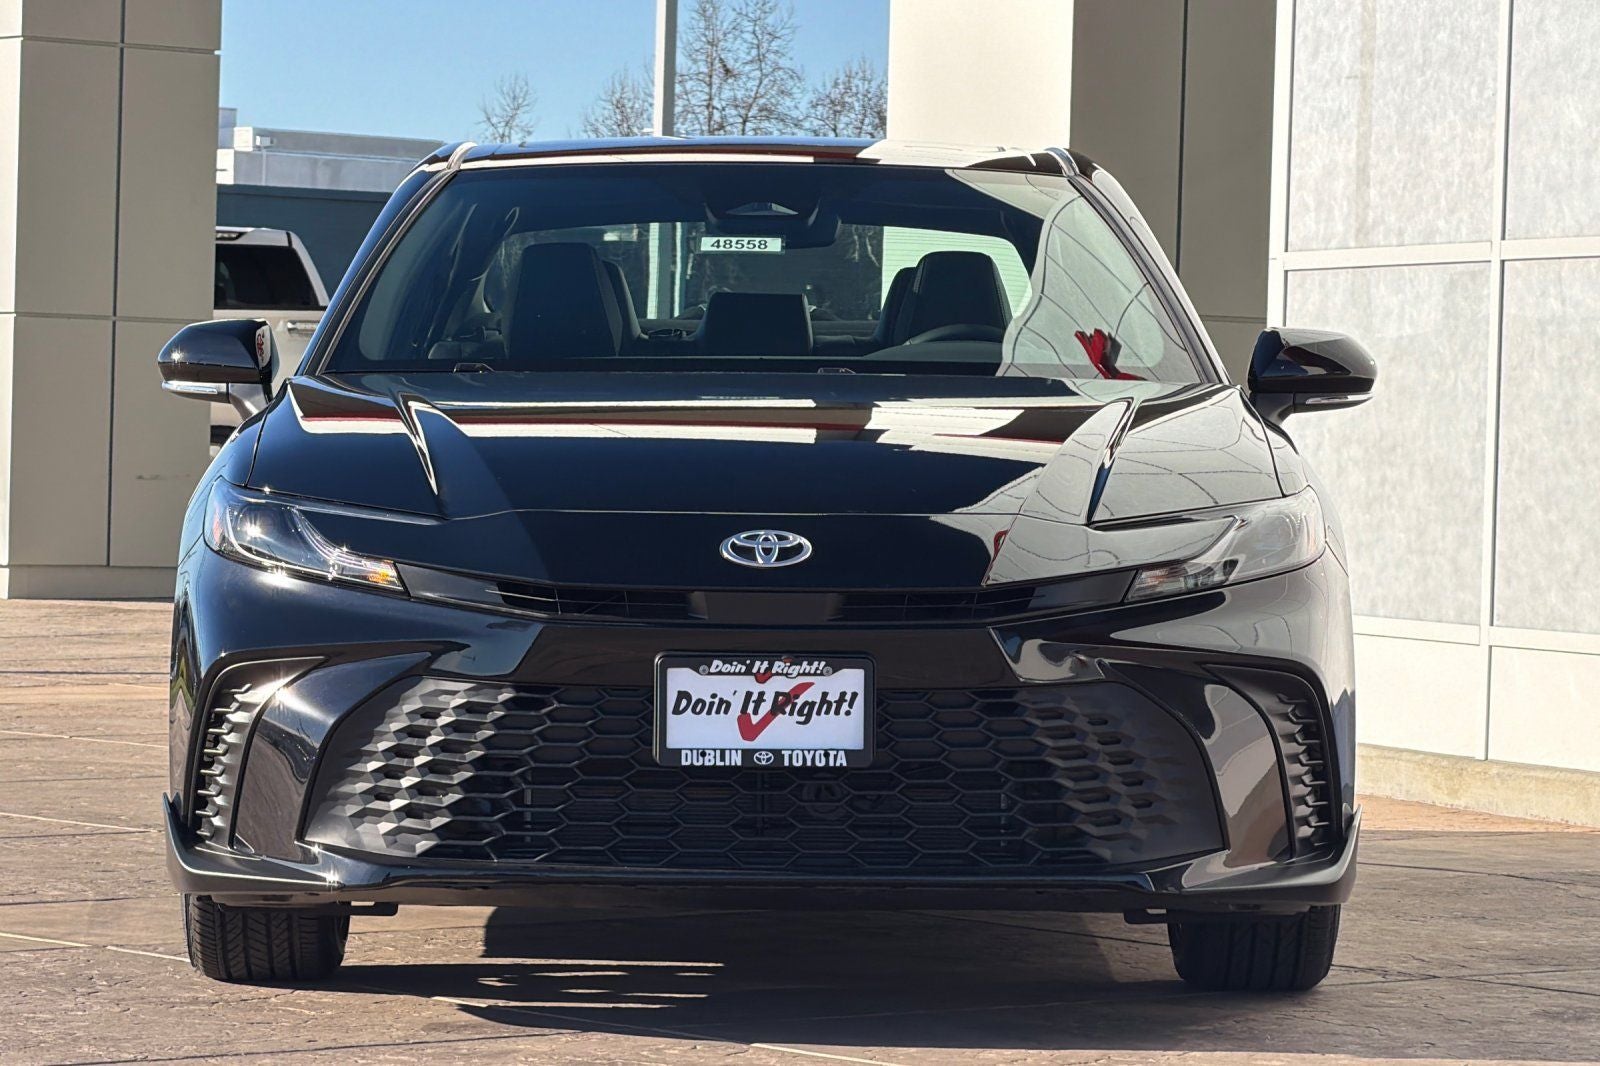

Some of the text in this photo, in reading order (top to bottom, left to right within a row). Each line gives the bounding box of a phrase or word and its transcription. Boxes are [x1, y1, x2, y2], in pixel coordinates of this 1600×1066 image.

[710, 239, 768, 250] 48558
[709, 659, 826, 679] Doin' It Right!
[671, 690, 859, 725] Doin' It Right!
[681, 750, 847, 767] DUBLIN TOYOTA
